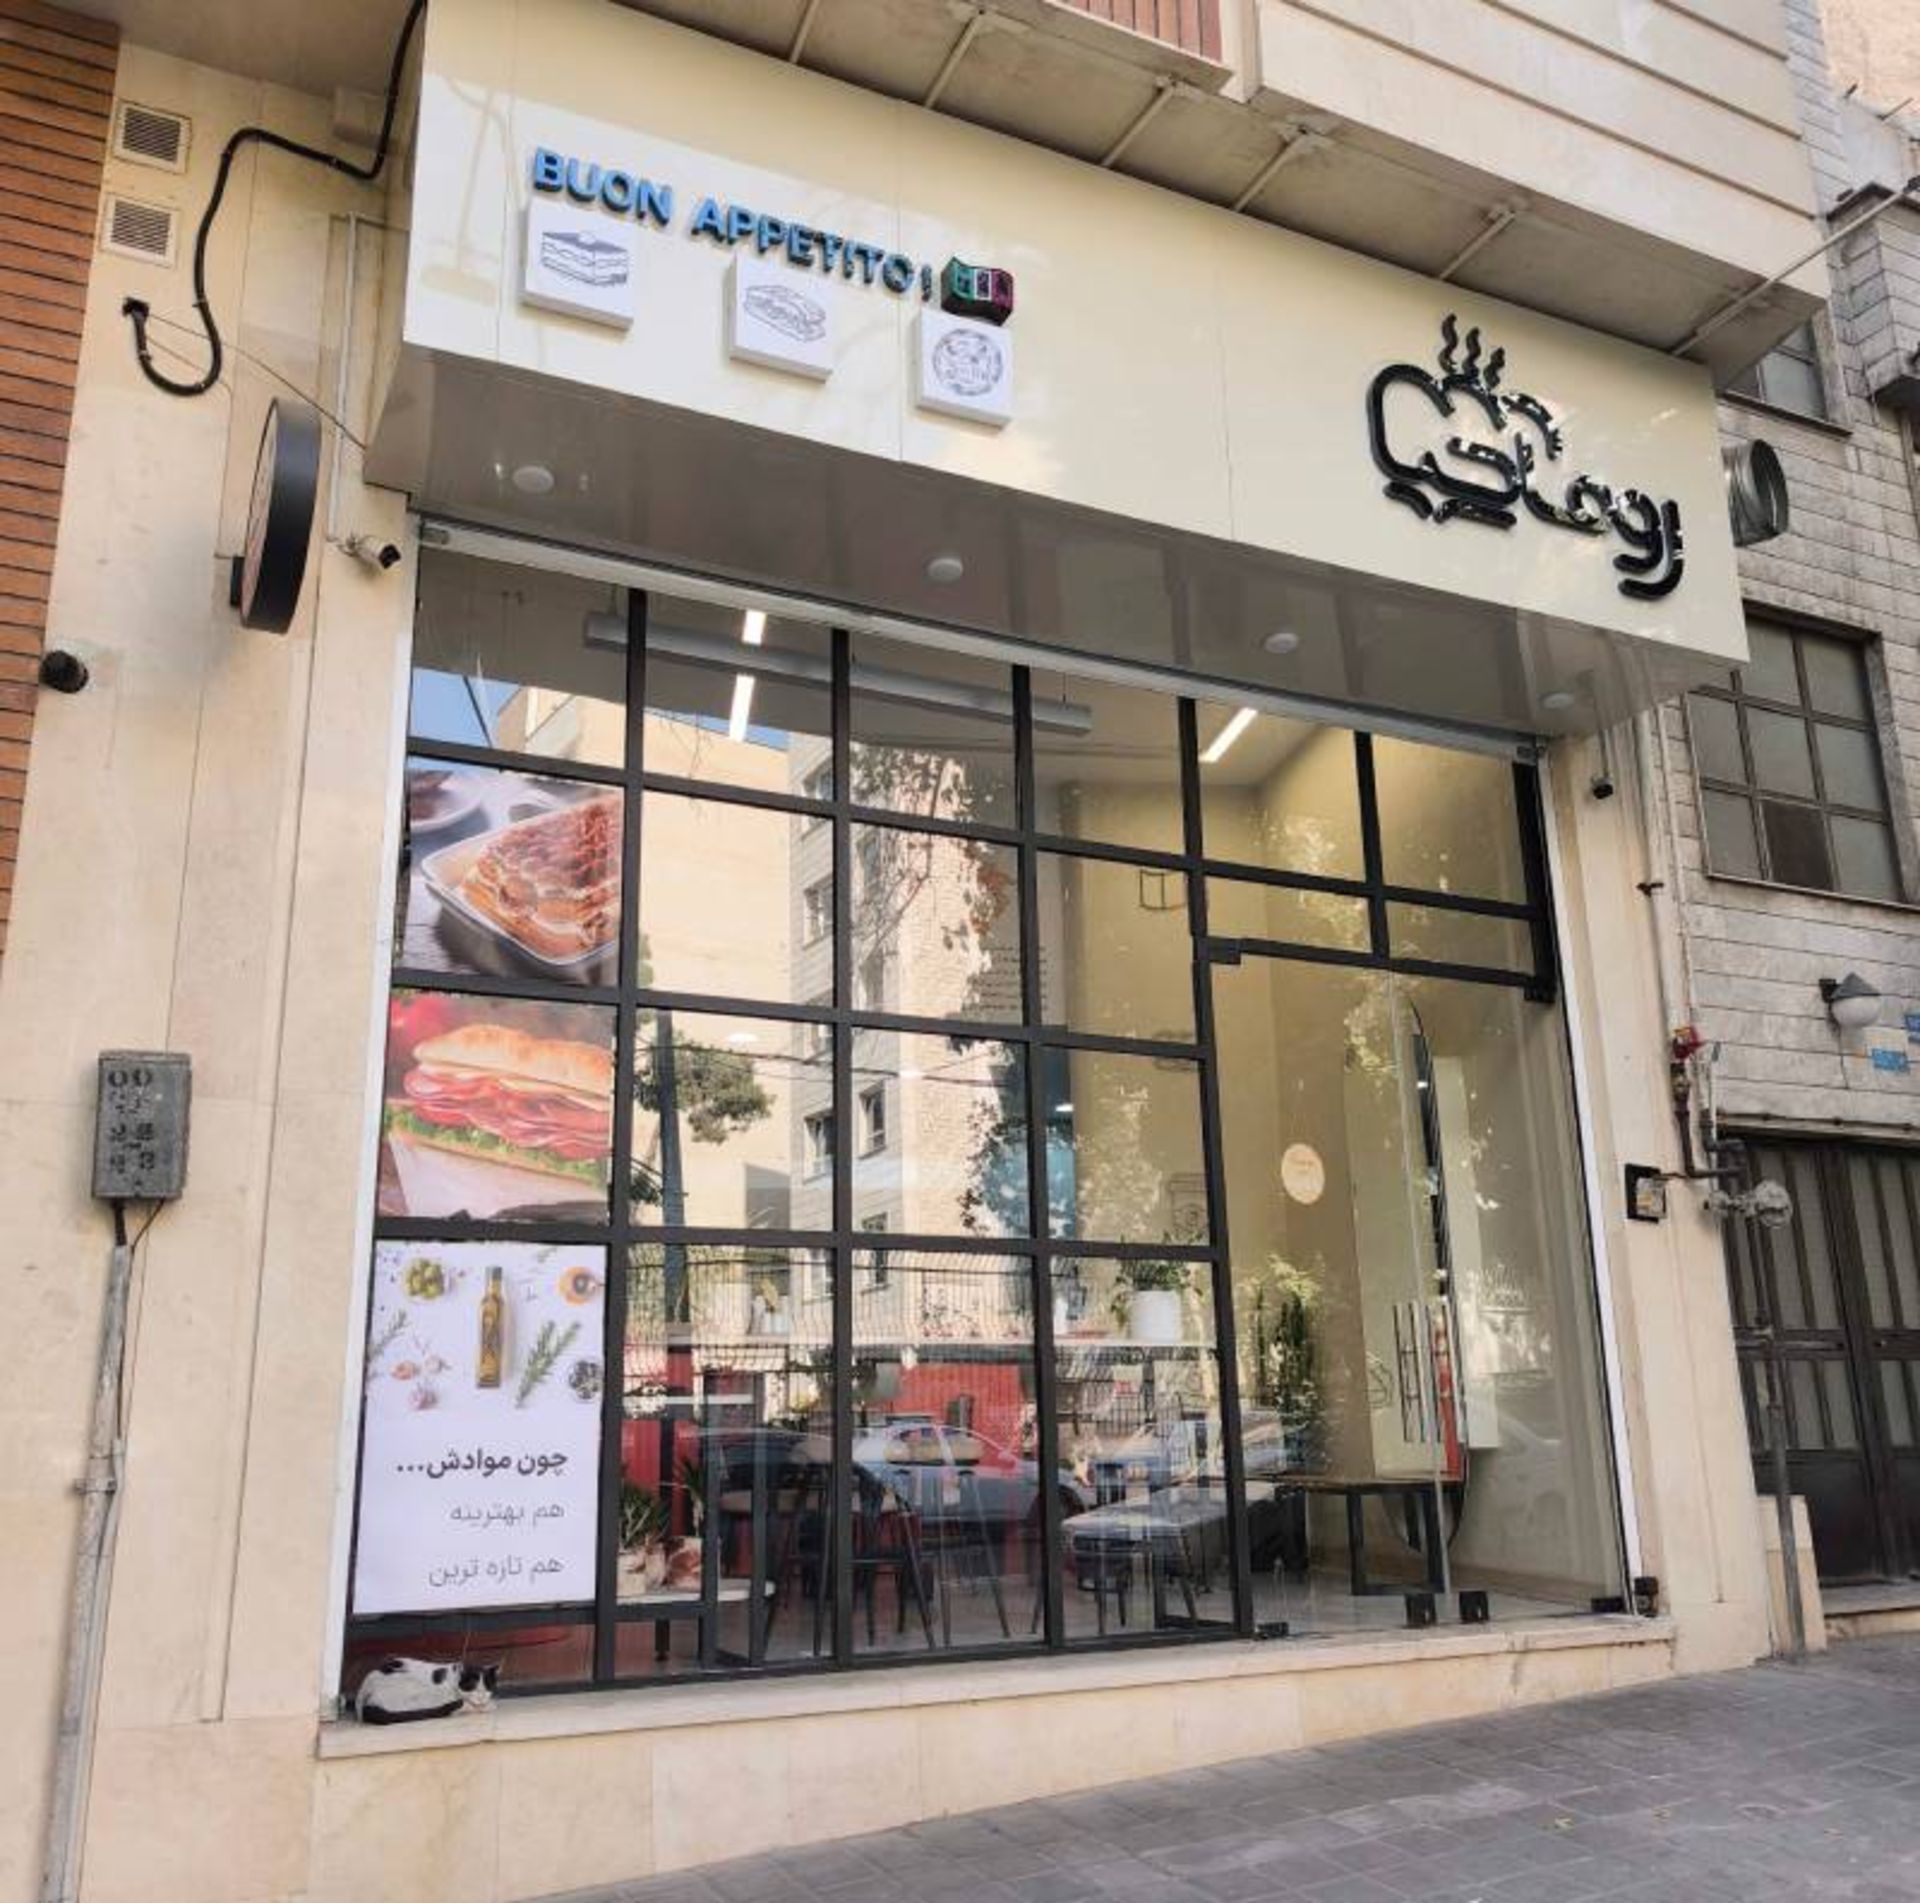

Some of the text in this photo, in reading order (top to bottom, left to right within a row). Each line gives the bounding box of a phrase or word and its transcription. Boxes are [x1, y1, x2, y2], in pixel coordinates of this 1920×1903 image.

[533, 147, 674, 226] BUON
[396, 1448, 568, 1479] چون موادش...
[450, 1503, 566, 1529] هم بهترینه
[429, 1554, 566, 1587] هم تازه ترین
